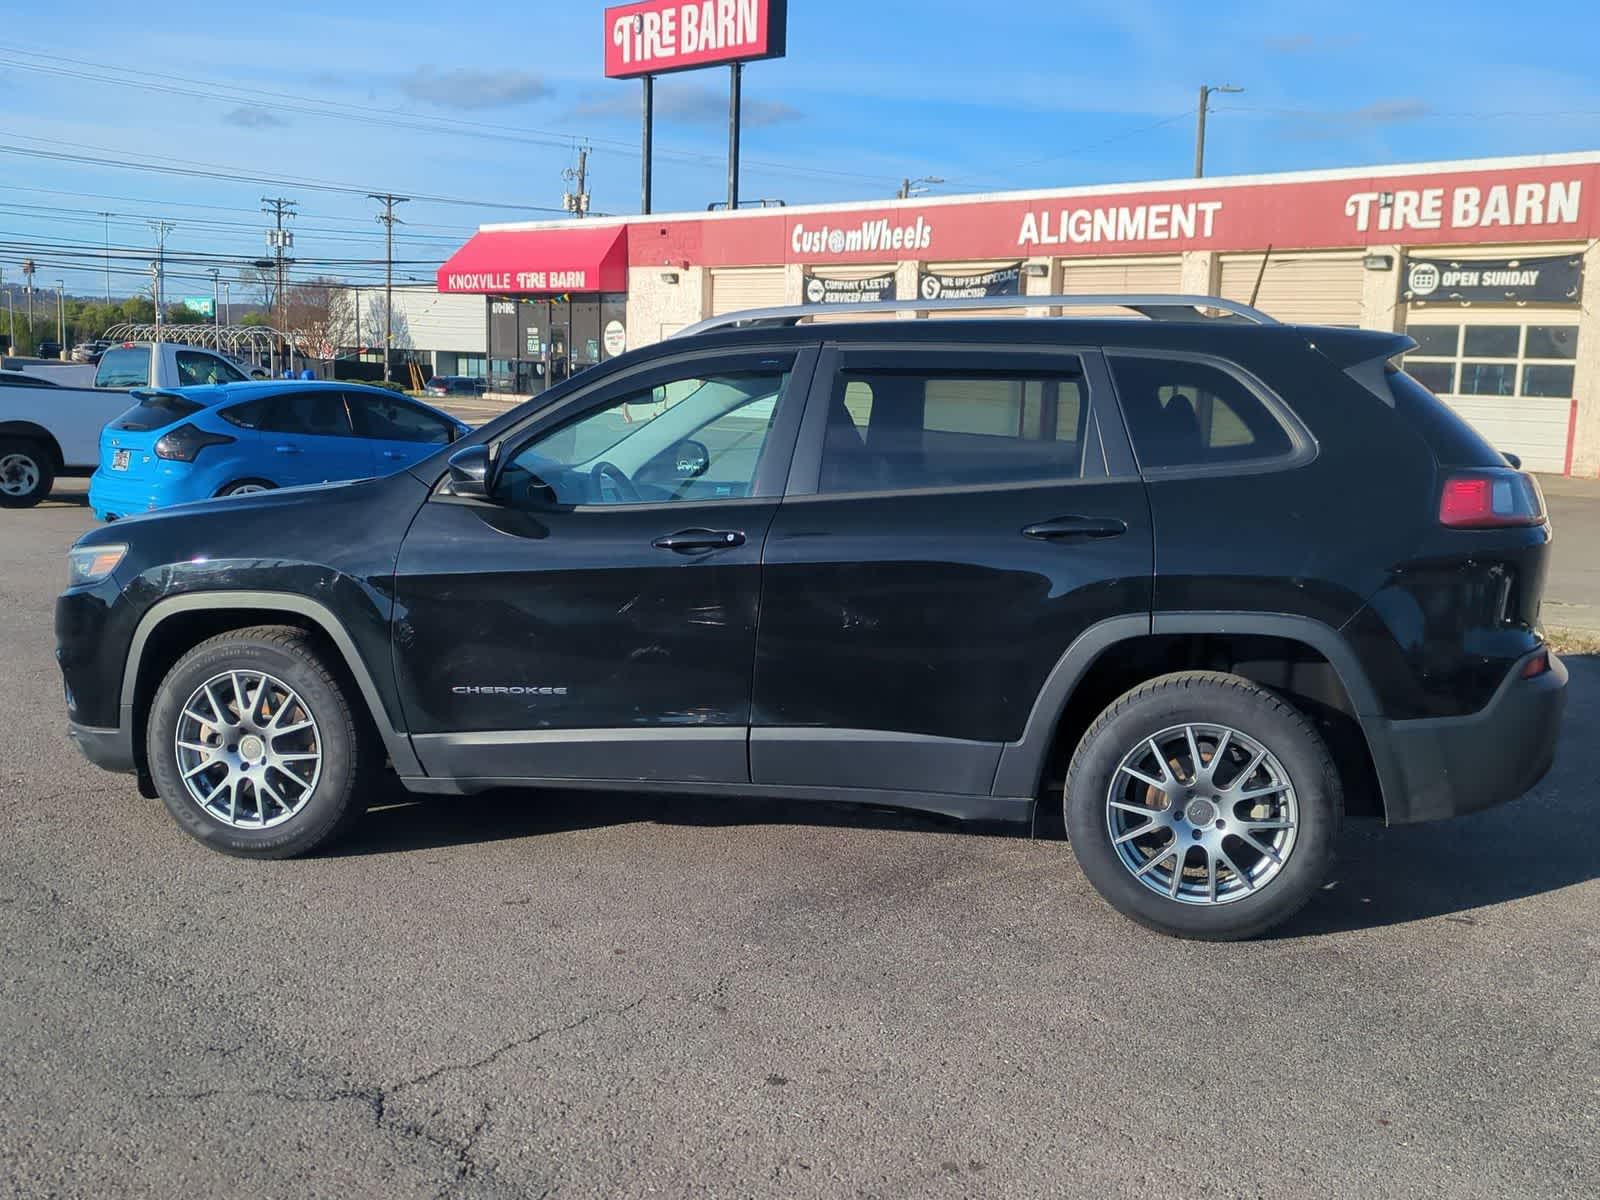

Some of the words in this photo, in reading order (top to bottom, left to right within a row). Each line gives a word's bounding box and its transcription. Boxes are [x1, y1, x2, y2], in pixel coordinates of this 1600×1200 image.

[680, 0, 759, 54] BARN
[1451, 180, 1582, 228] BARN
[1017, 201, 1223, 246] ALIGNMENT
[448, 273, 511, 289] KNOXVILLE
[549, 271, 585, 288] BARN
[824, 280, 859, 290] COMPANY
[941, 277, 954, 286] WE
[1442, 271, 1479, 287] OPEN
[1482, 270, 1540, 287] SUNDAY
[825, 292, 860, 303] SERVICED
[451, 686, 568, 696] CHEROKEE
